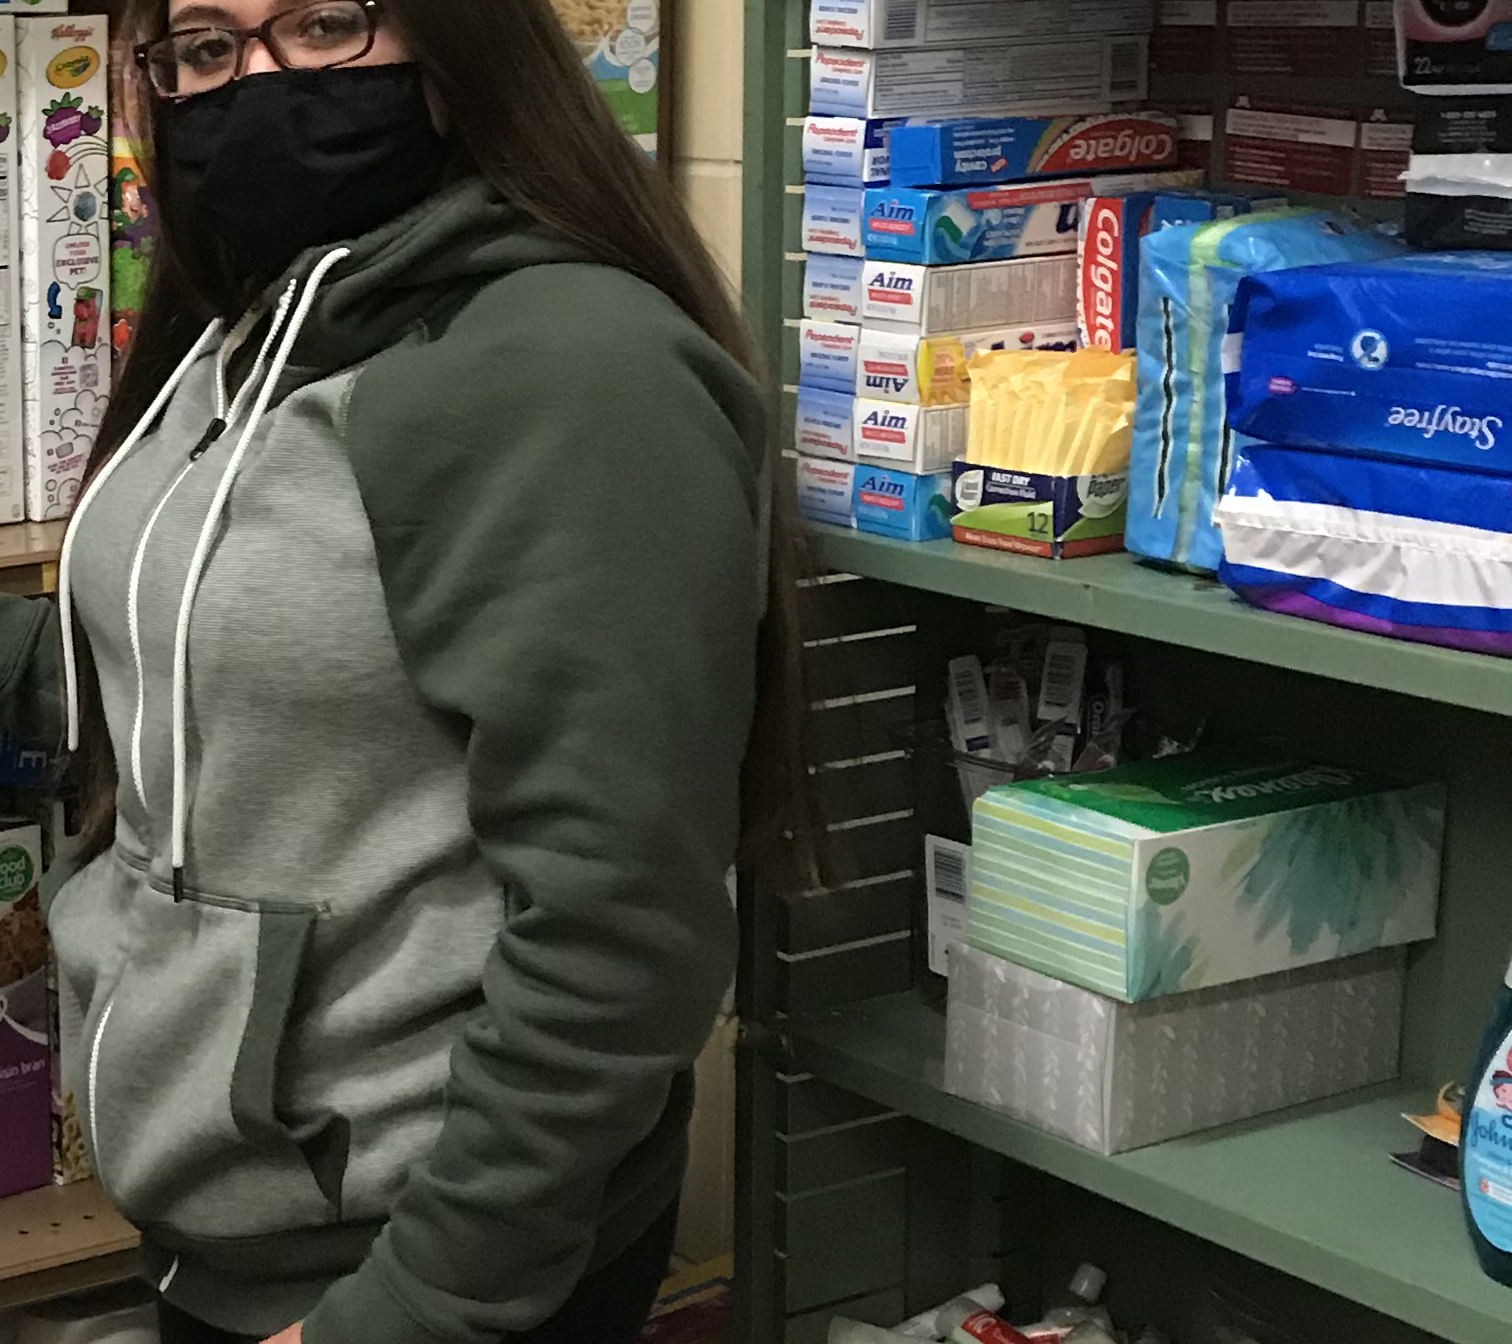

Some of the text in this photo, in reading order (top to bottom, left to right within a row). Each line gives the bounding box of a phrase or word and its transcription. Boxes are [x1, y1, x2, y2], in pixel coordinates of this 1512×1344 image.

[1414, 57, 1432, 75] 22
[1068, 128, 1174, 163] Colgate
[870, 199, 916, 222] Aim
[55, 256, 100, 268] EXCLUSIVE
[69, 266, 87, 276] PET!
[868, 270, 914, 291] Aim
[1090, 207, 1120, 353] Colgate
[864, 374, 911, 395] Aim
[861, 409, 908, 431] Aim
[1386, 403, 1503, 451] Stayfree
[859, 475, 905, 498] Aim
[991, 471, 1032, 487] FAST DRY
[1026, 511, 1049, 534] 12
[21, 1057, 46, 1076] bran
